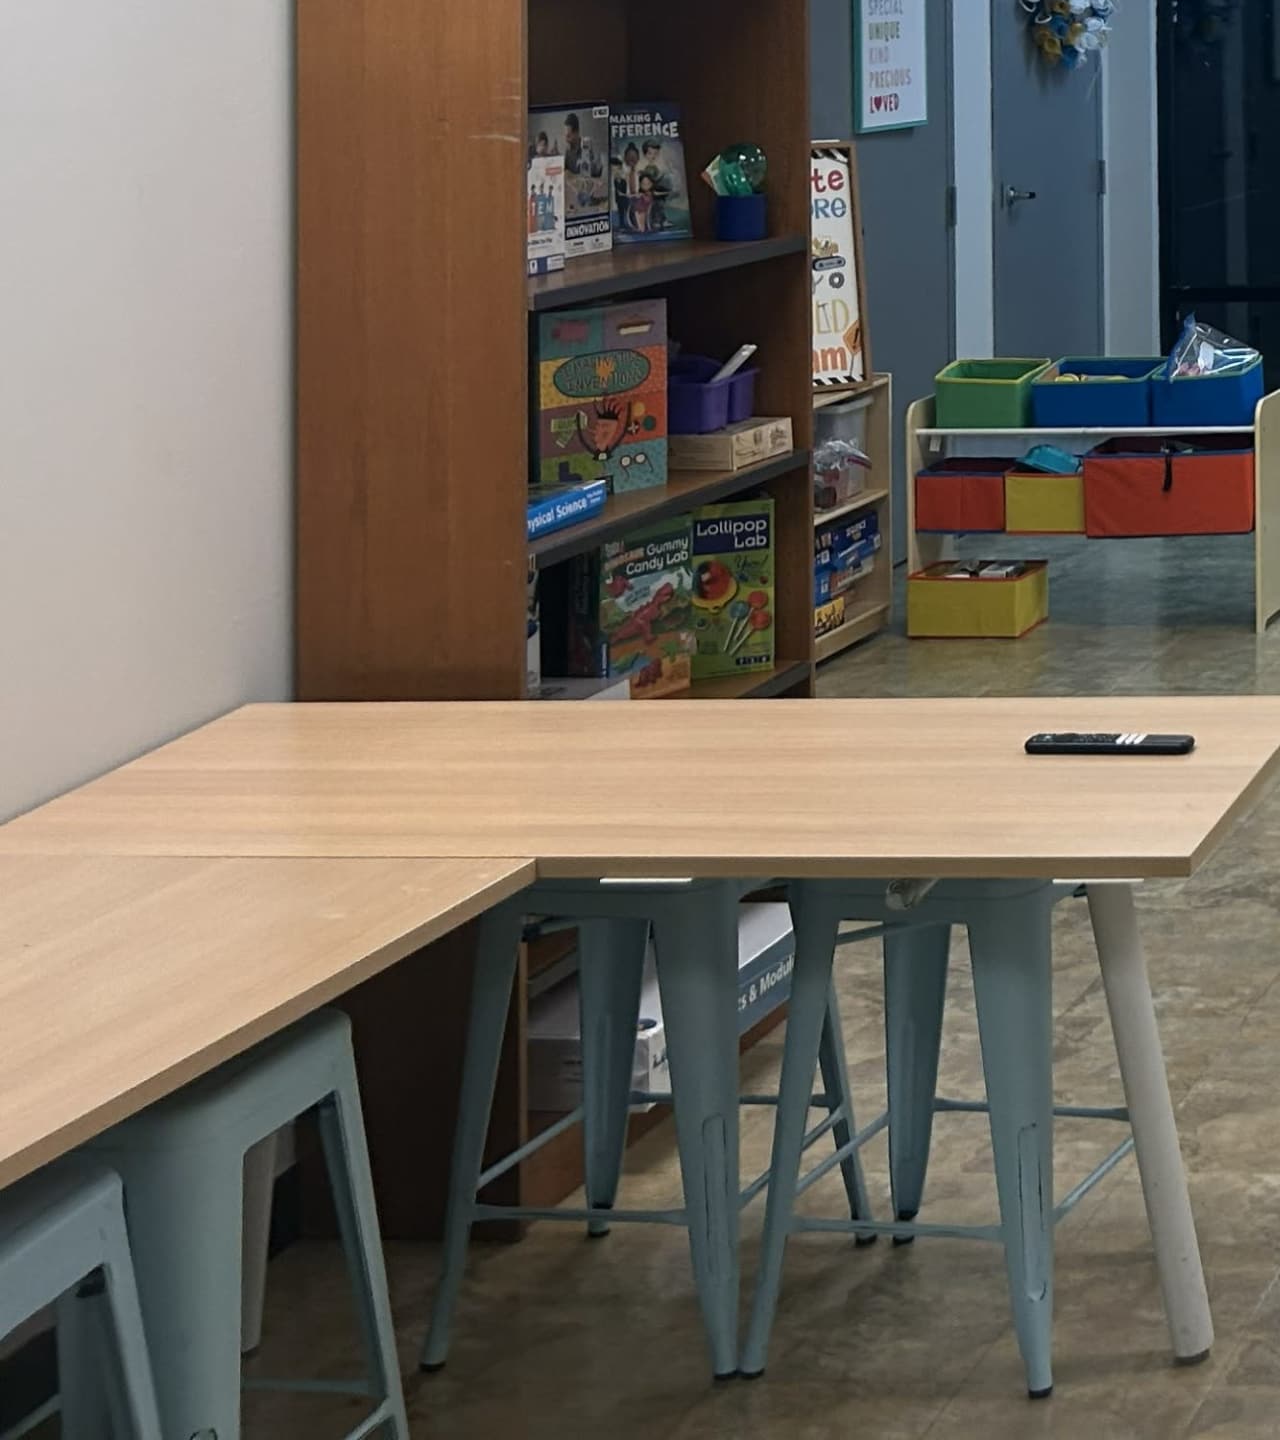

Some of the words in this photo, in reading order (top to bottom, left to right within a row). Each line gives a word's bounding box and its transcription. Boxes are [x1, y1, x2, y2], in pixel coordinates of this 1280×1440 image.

[869, 21, 900, 42] UNIQUE
[869, 69, 912, 88] PRECIOUS
[609, 113, 651, 124] MAKING
[654, 112, 663, 122] A
[610, 121, 679, 138] FFERENCE
[811, 168, 844, 193] te
[566, 221, 610, 238] INNOVATION
[556, 496, 588, 518] Science
[696, 519, 768, 536] Lollipop
[646, 536, 689, 556] Gummy
[734, 535, 768, 548] Lab
[625, 556, 664, 575] Candy
[666, 550, 689, 565] Lab
[749, 983, 758, 1004] &
